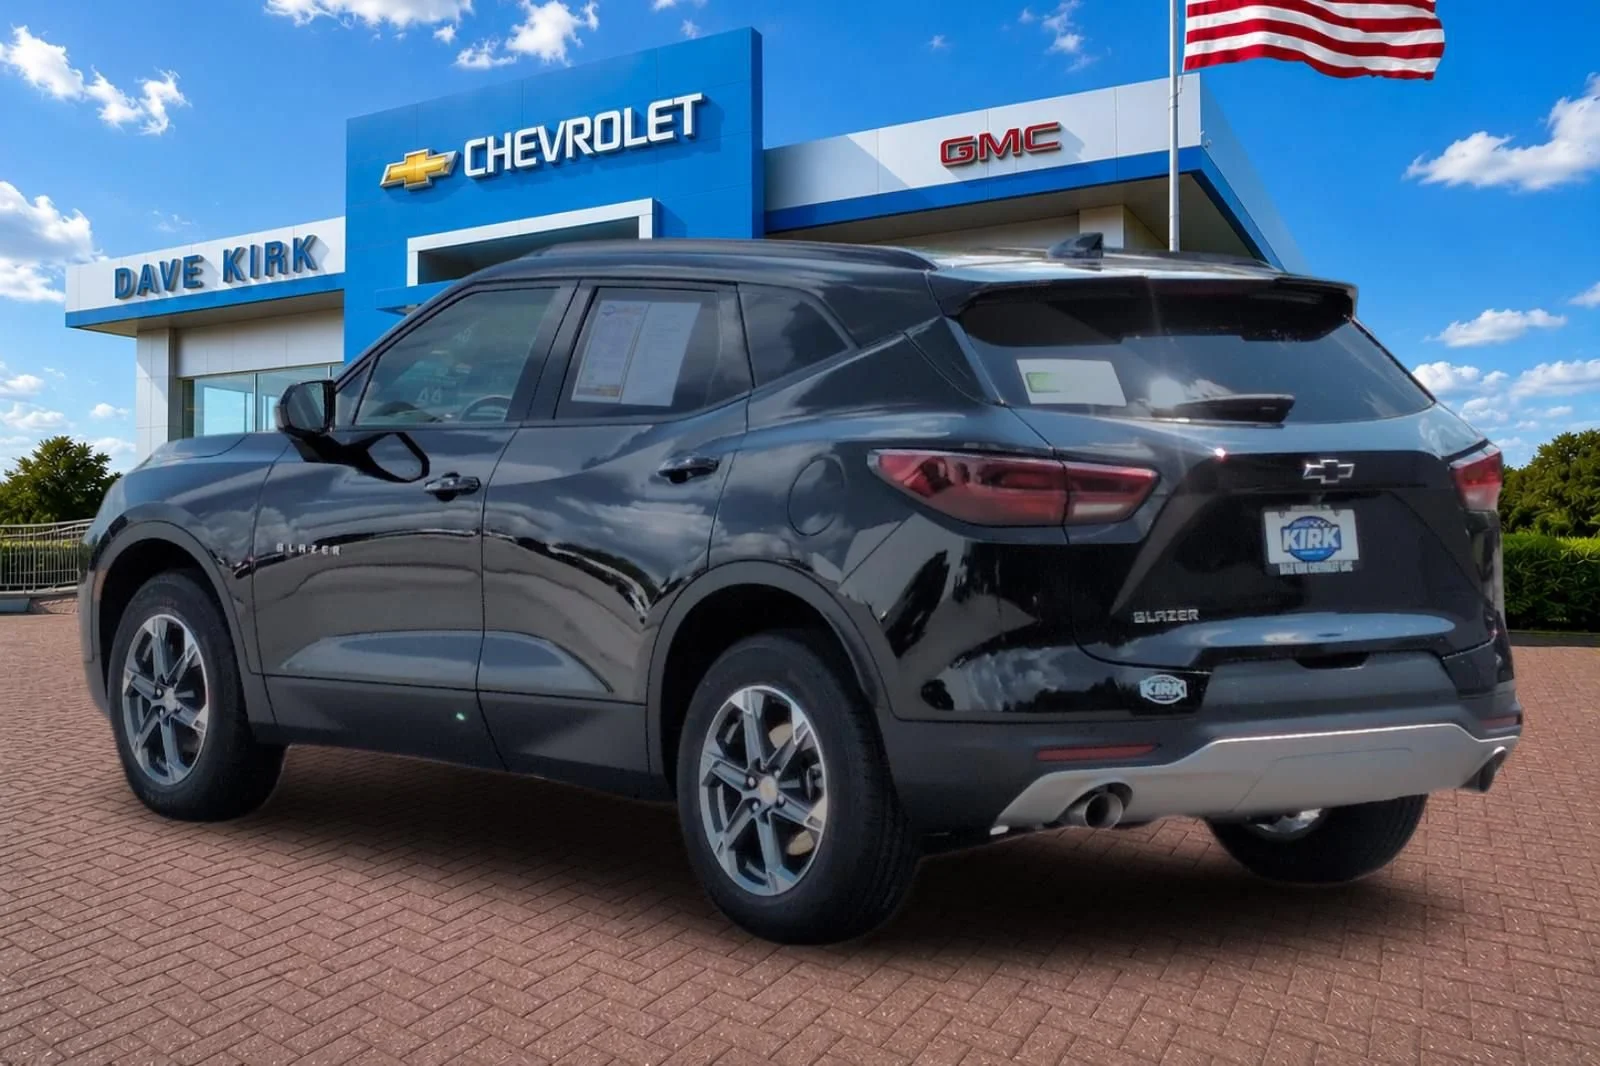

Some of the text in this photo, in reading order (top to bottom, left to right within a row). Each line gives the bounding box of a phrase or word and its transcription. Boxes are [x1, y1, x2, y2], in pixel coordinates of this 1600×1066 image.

[463, 92, 704, 178] CHEVROLET
[939, 121, 1061, 167] GMC
[114, 234, 324, 300] DAVE KIRK
[276, 543, 341, 556] BLAZER
[1283, 527, 1340, 550] KIRK
[1133, 609, 1199, 624] BLAZER
[1141, 681, 1186, 696] KIRK
